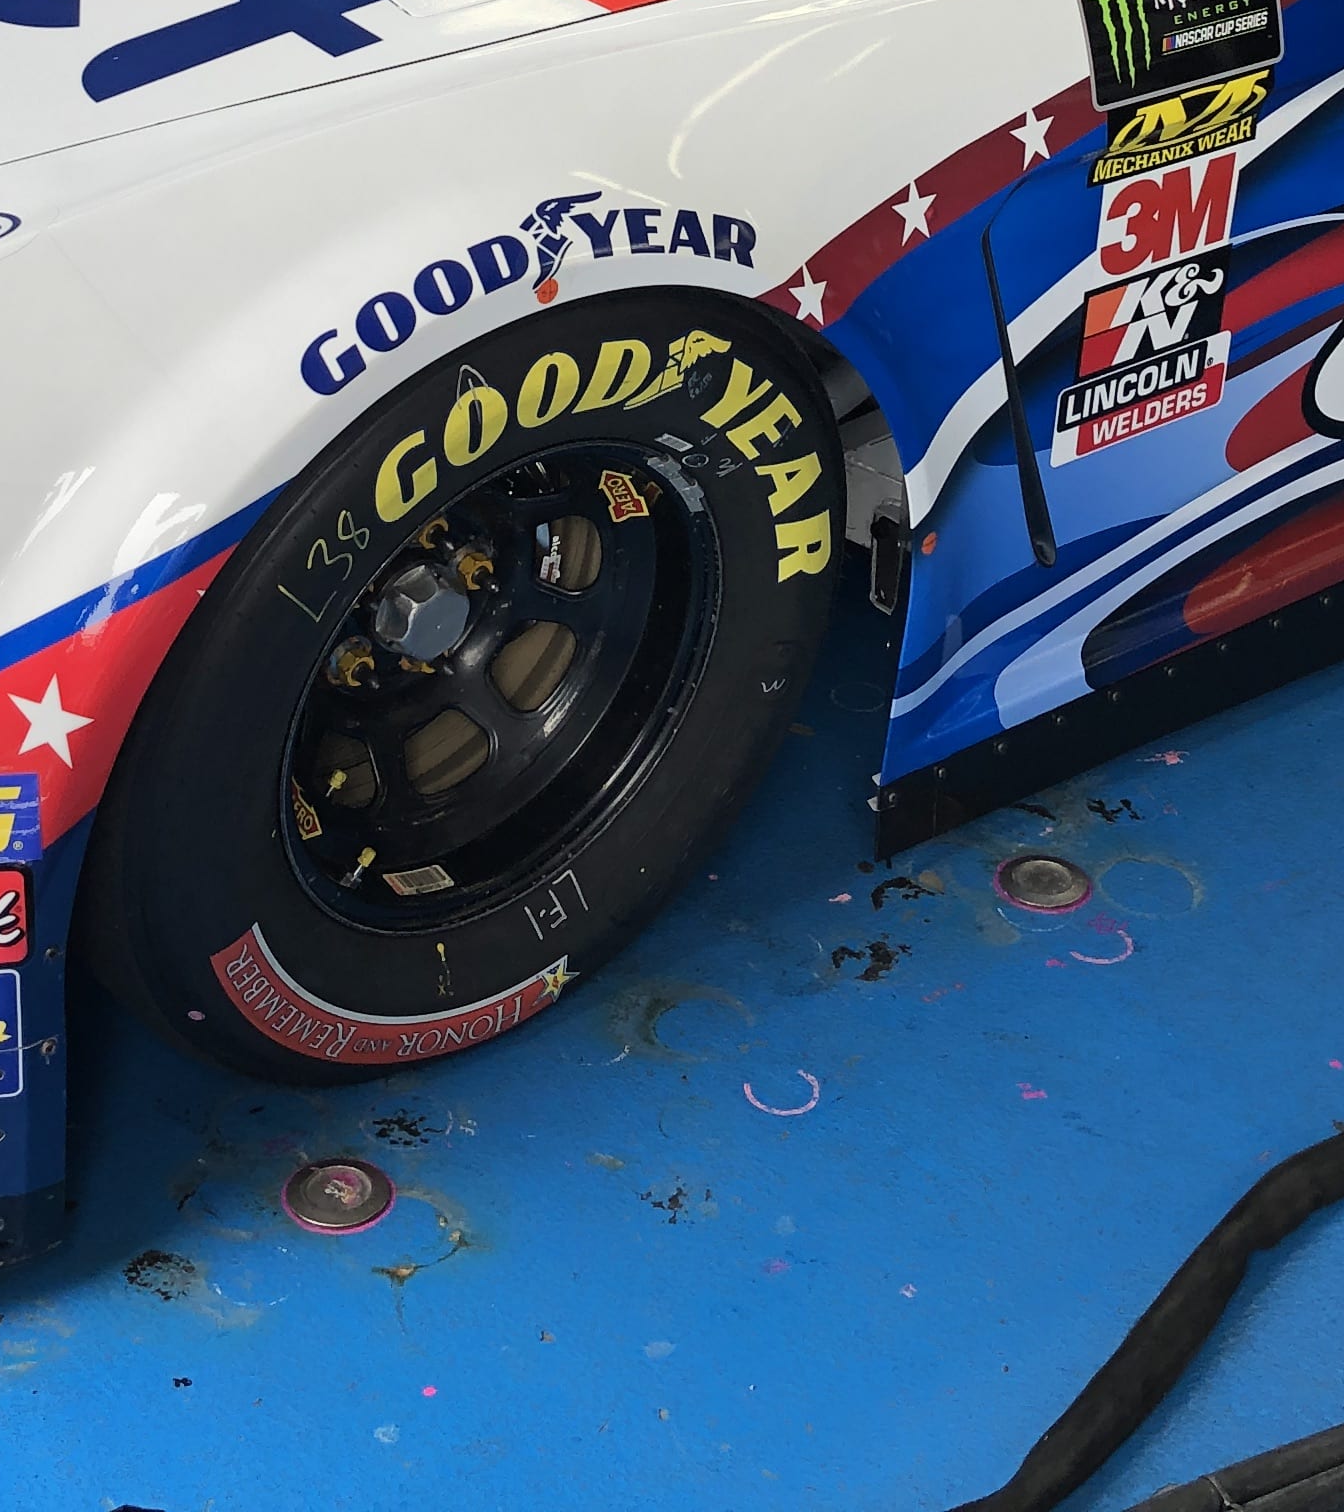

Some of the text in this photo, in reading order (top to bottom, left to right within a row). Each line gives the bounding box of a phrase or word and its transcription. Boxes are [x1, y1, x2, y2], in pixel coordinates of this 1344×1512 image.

[1174, 11, 1269, 49] NASCAR CUP SERIES
[1092, 116, 1253, 183] MECHANIX WEAR
[1099, 151, 1237, 276] 3M
[1108, 262, 1225, 367] K&N
[1064, 348, 1200, 425] LINCOLN
[1091, 382, 1208, 447] WELDERS
[607, 477, 637, 513] AERO
[225, 942, 523, 1060] HONOR AND REMEMBER
